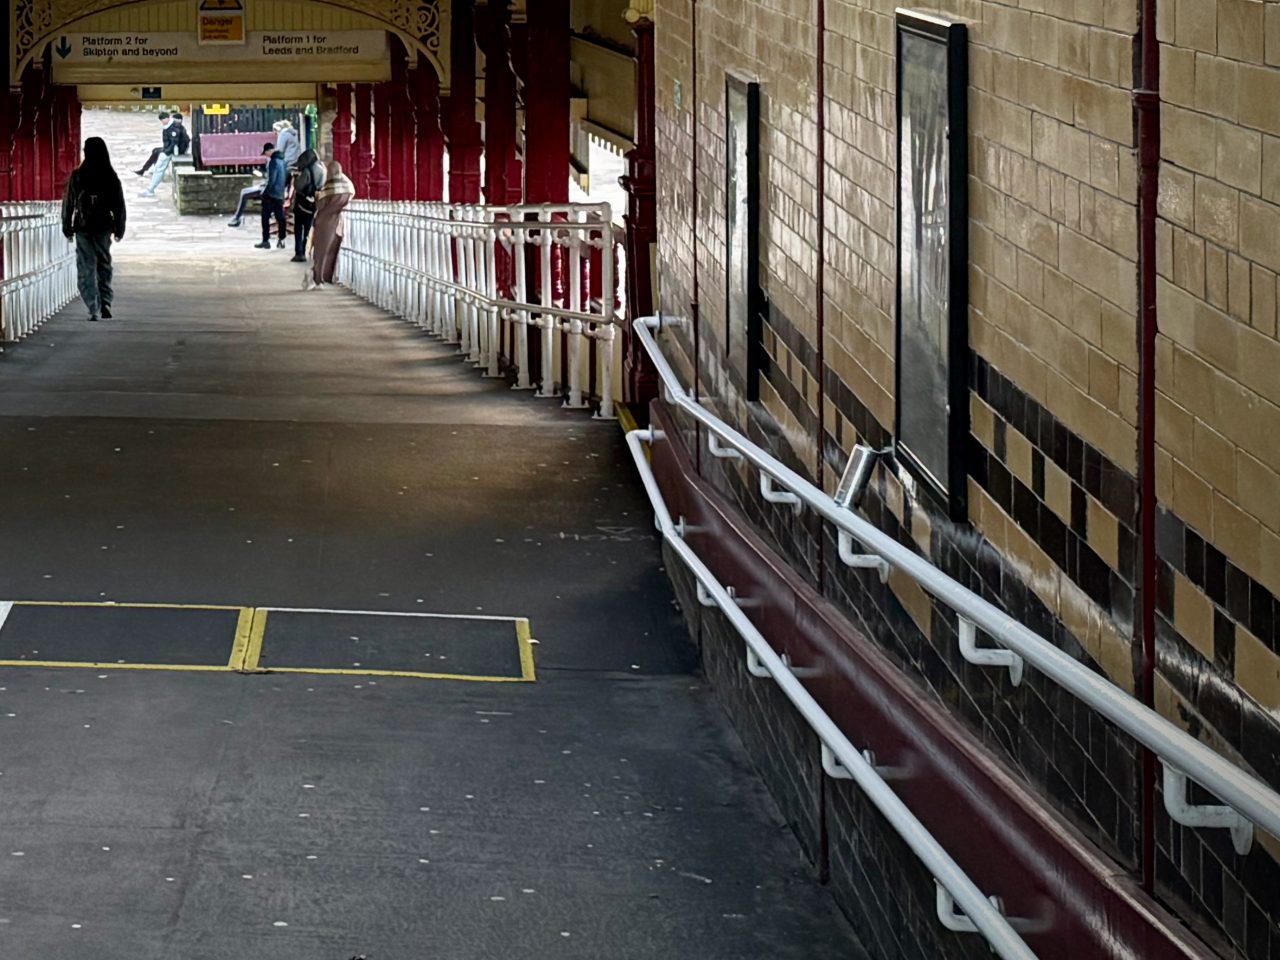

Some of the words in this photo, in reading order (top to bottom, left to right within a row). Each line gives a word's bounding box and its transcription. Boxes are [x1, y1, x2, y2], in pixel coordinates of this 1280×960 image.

[82, 36, 123, 45] Platform
[125, 36, 132, 45] 2
[135, 36, 148, 45] for
[262, 35, 304, 44] Platform
[313, 35, 327, 44] for
[83, 47, 119, 57] Skipton
[122, 47, 139, 56] and
[142, 47, 178, 57] beyond
[262, 46, 292, 55] Leeds
[295, 46, 313, 55] and
[316, 45, 359, 54] Bradford
